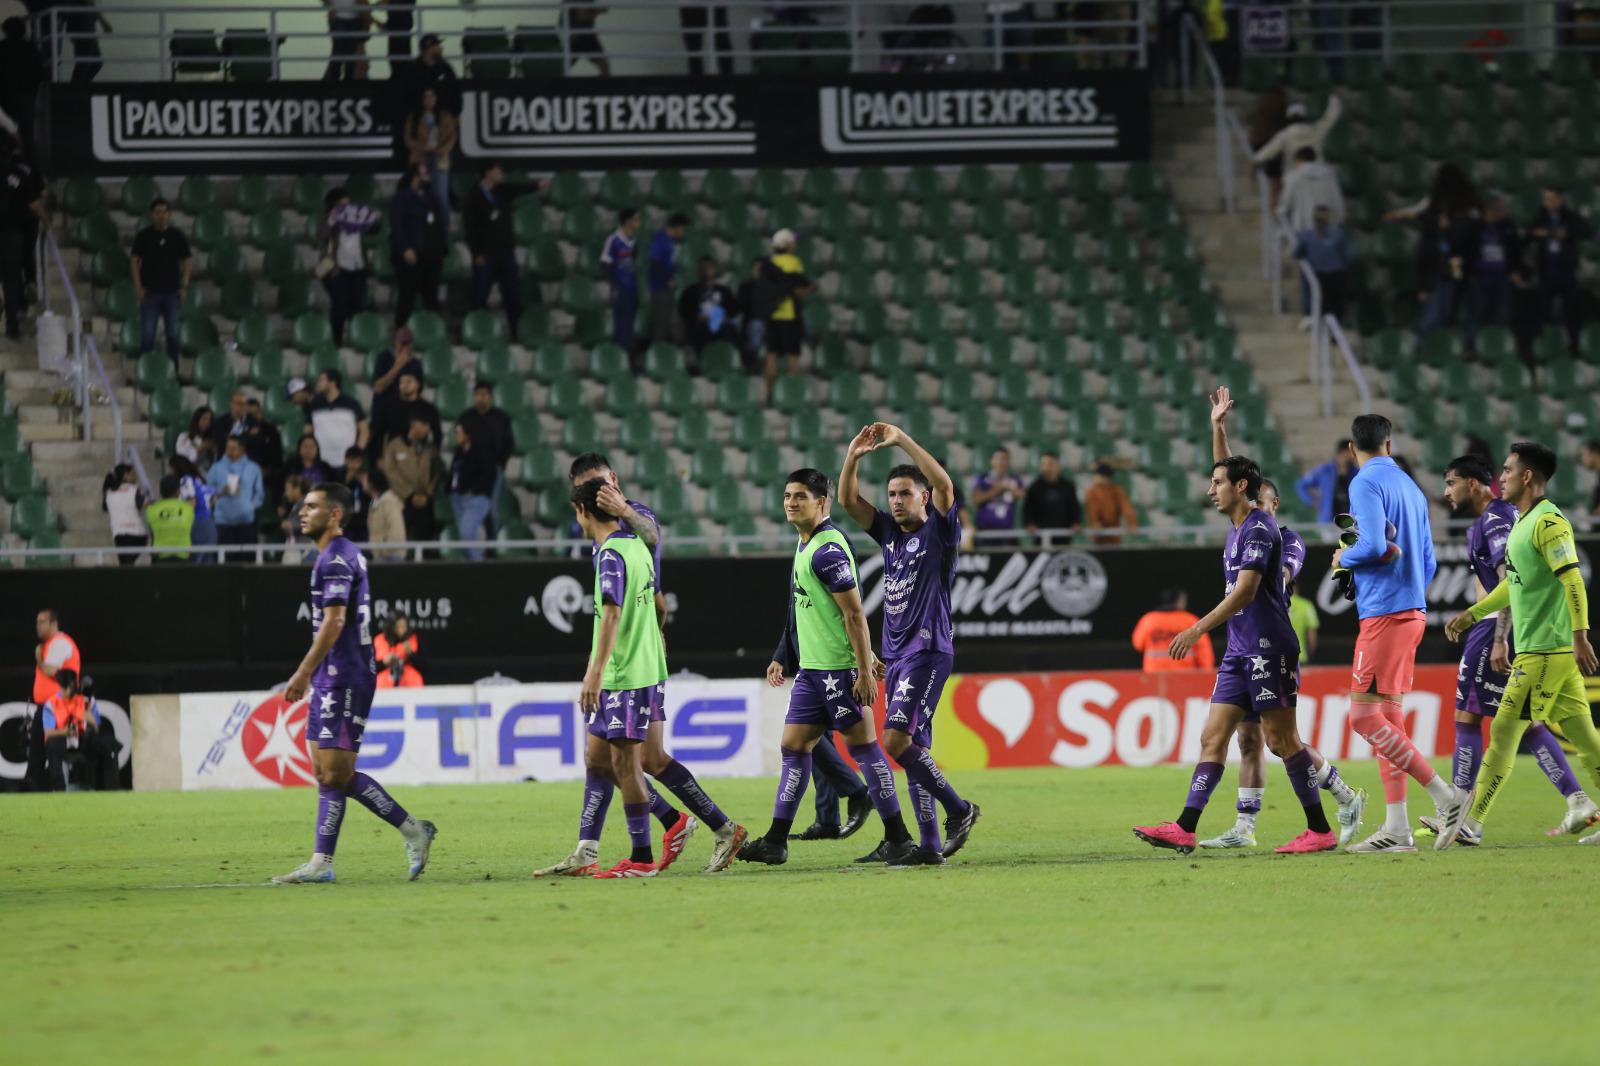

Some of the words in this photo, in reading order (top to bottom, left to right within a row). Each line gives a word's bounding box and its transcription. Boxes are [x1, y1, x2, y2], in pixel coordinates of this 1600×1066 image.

[125, 98, 373, 136] PAQUETEXPRESS
[493, 94, 737, 132] PAQUETEXPRESS
[853, 88, 1099, 127] PAQUETEXPRESS
[296, 598, 452, 621] ARNUS
[1255, 694, 1278, 702] PIRMA
[197, 698, 250, 776] TENIS
[354, 697, 748, 769] STAS
[785, 768, 803, 800] ITALIKA
[872, 759, 895, 790] ITALIKA
[1480, 775, 1504, 813] ITALIKA
